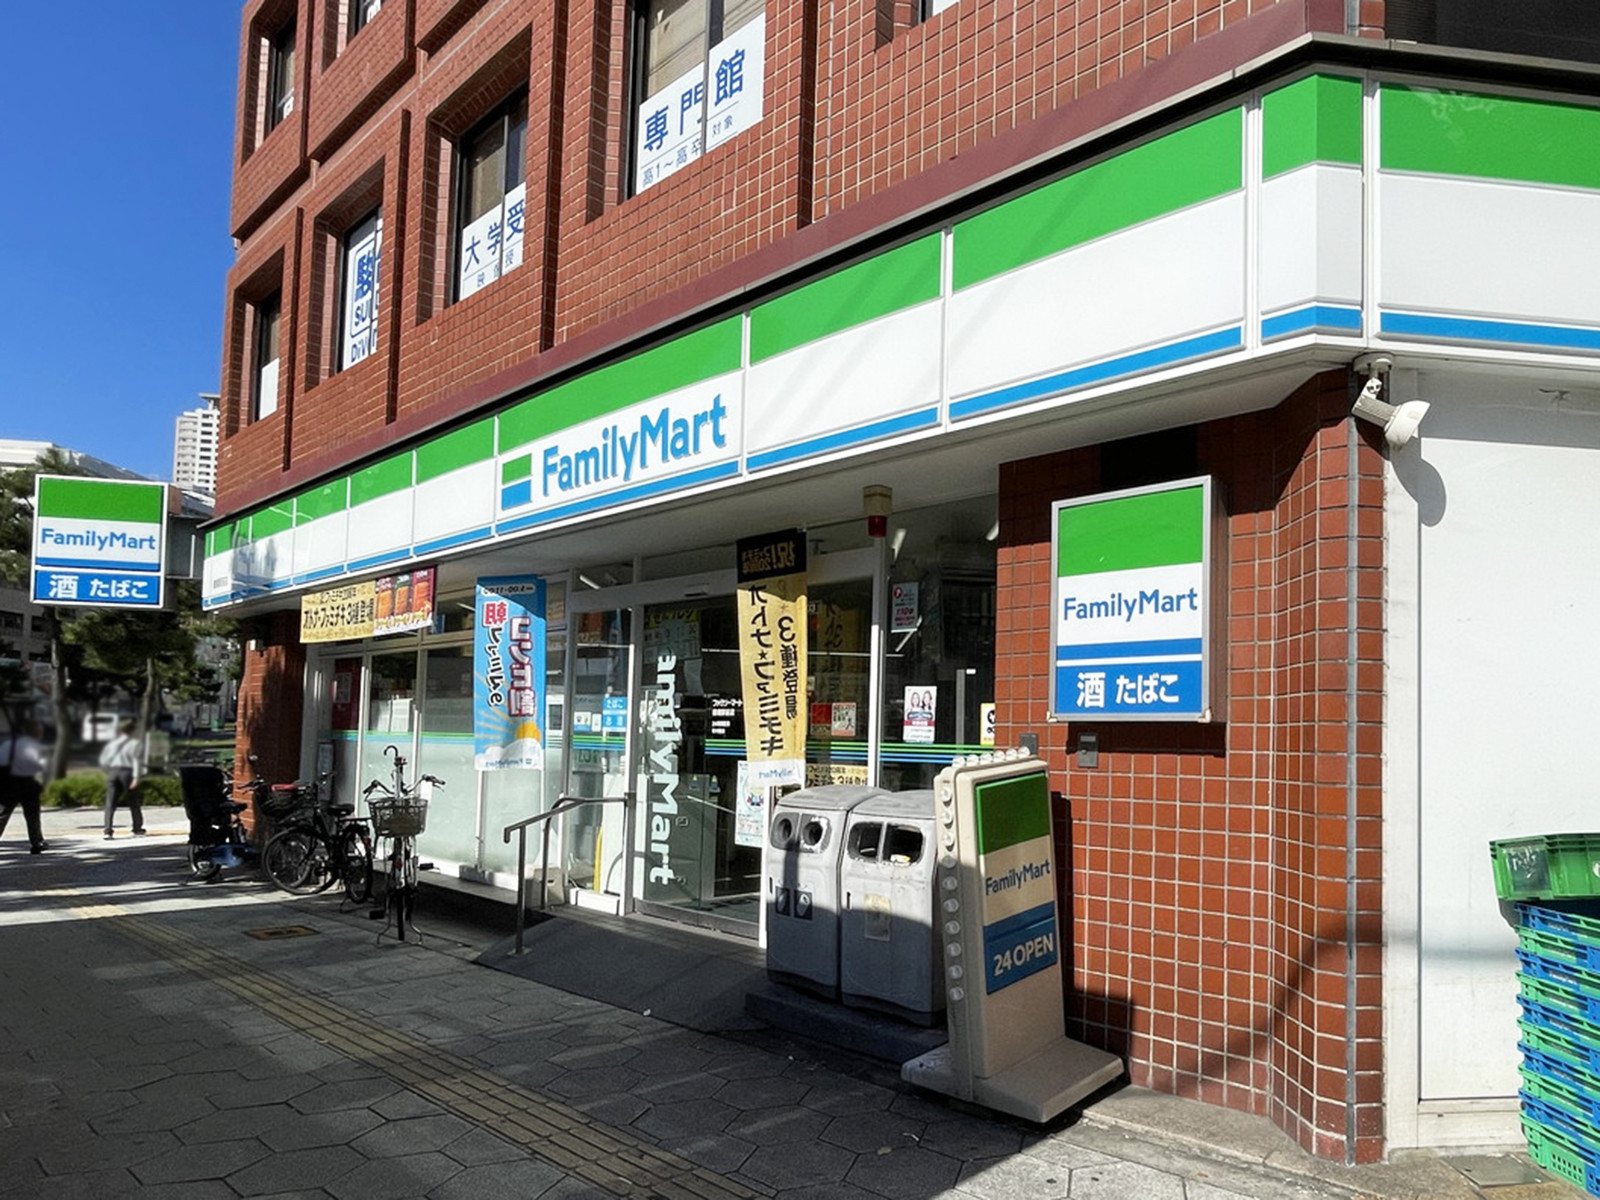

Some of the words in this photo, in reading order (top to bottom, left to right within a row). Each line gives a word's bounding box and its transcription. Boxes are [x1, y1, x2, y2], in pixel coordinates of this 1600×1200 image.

[543, 393, 727, 498] FamilyMart
[41, 528, 156, 551] FamilyMart
[48, 574, 79, 599] 酒
[89, 578, 149, 599] たばこ
[1063, 588, 1198, 623] FamilyMart
[1076, 671, 1106, 708] 酒
[1115, 672, 1180, 704] たばこ
[985, 859, 1050, 896] FamilyMart
